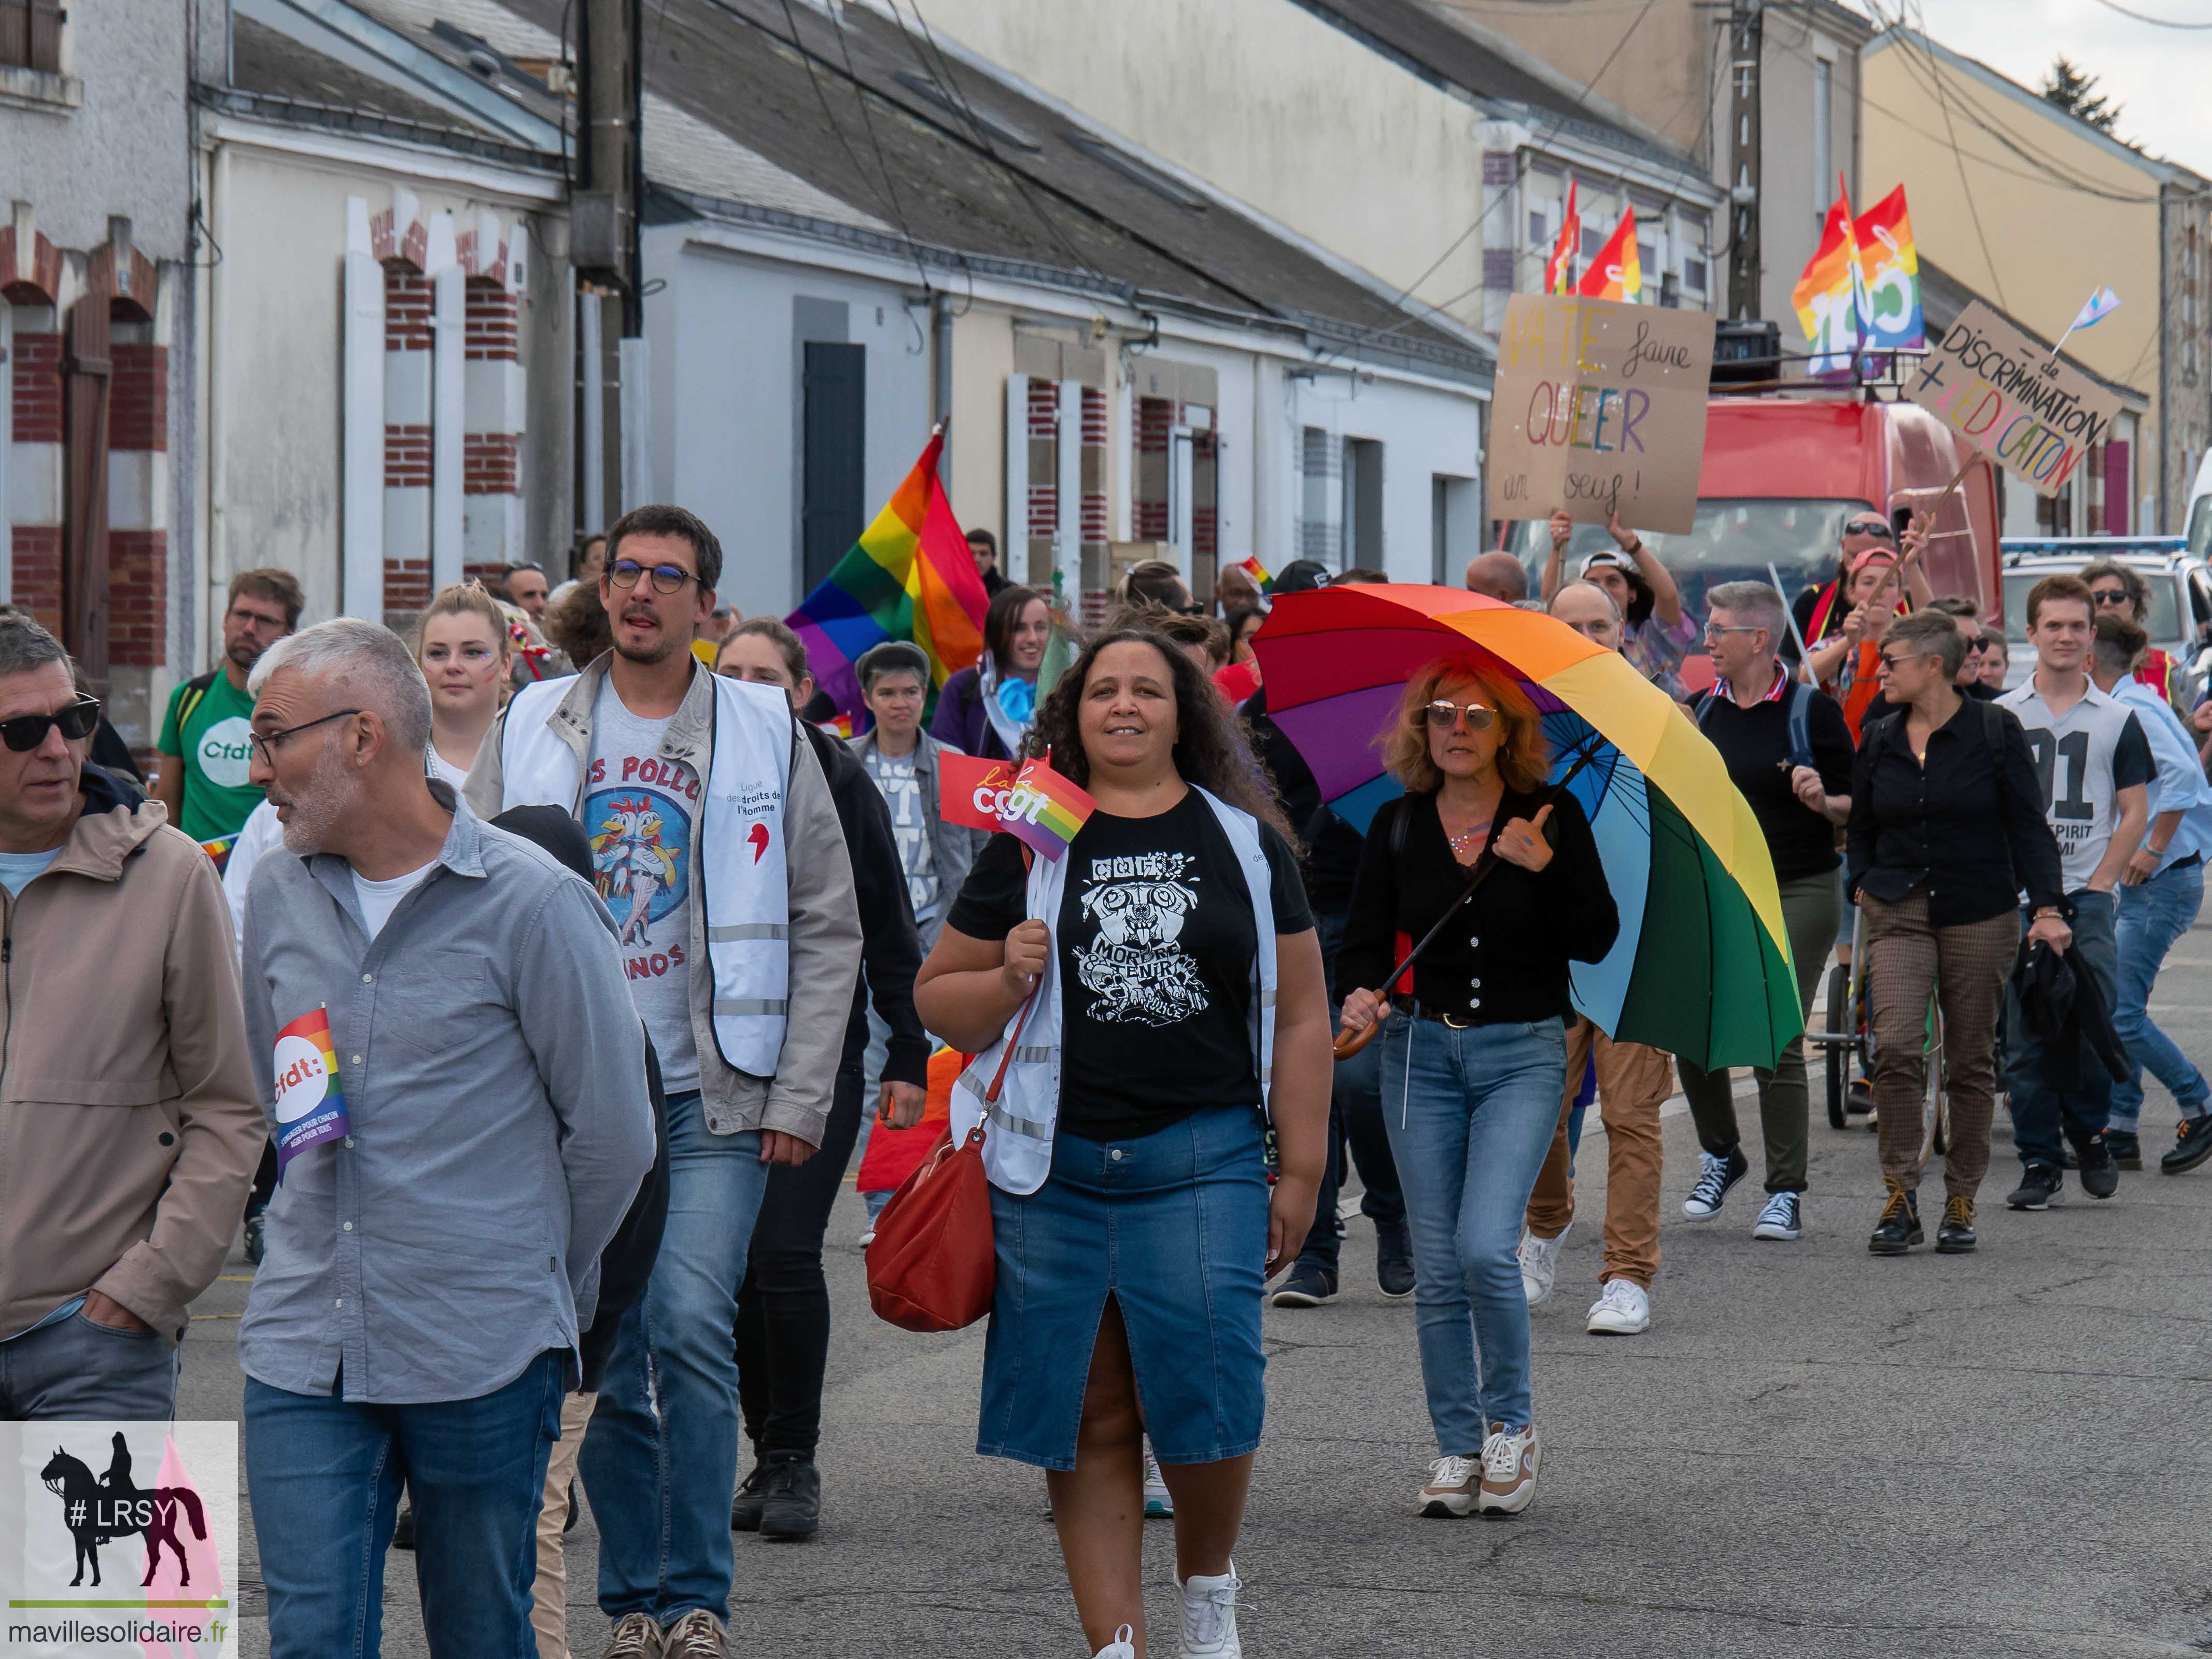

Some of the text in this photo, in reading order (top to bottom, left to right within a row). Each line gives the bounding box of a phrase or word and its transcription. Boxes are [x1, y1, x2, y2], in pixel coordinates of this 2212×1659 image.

[1622, 319, 1692, 379] faire
[2040, 358, 2060, 381] de
[1526, 381, 1651, 454] QUEER
[1504, 474, 1529, 501] un
[741, 780, 763, 793] Ligue
[726, 791, 781, 804] des droits de
[738, 805, 775, 816] l'Homme
[301, 1118, 319, 1131] POUR
[301, 1129, 318, 1142] POUR
